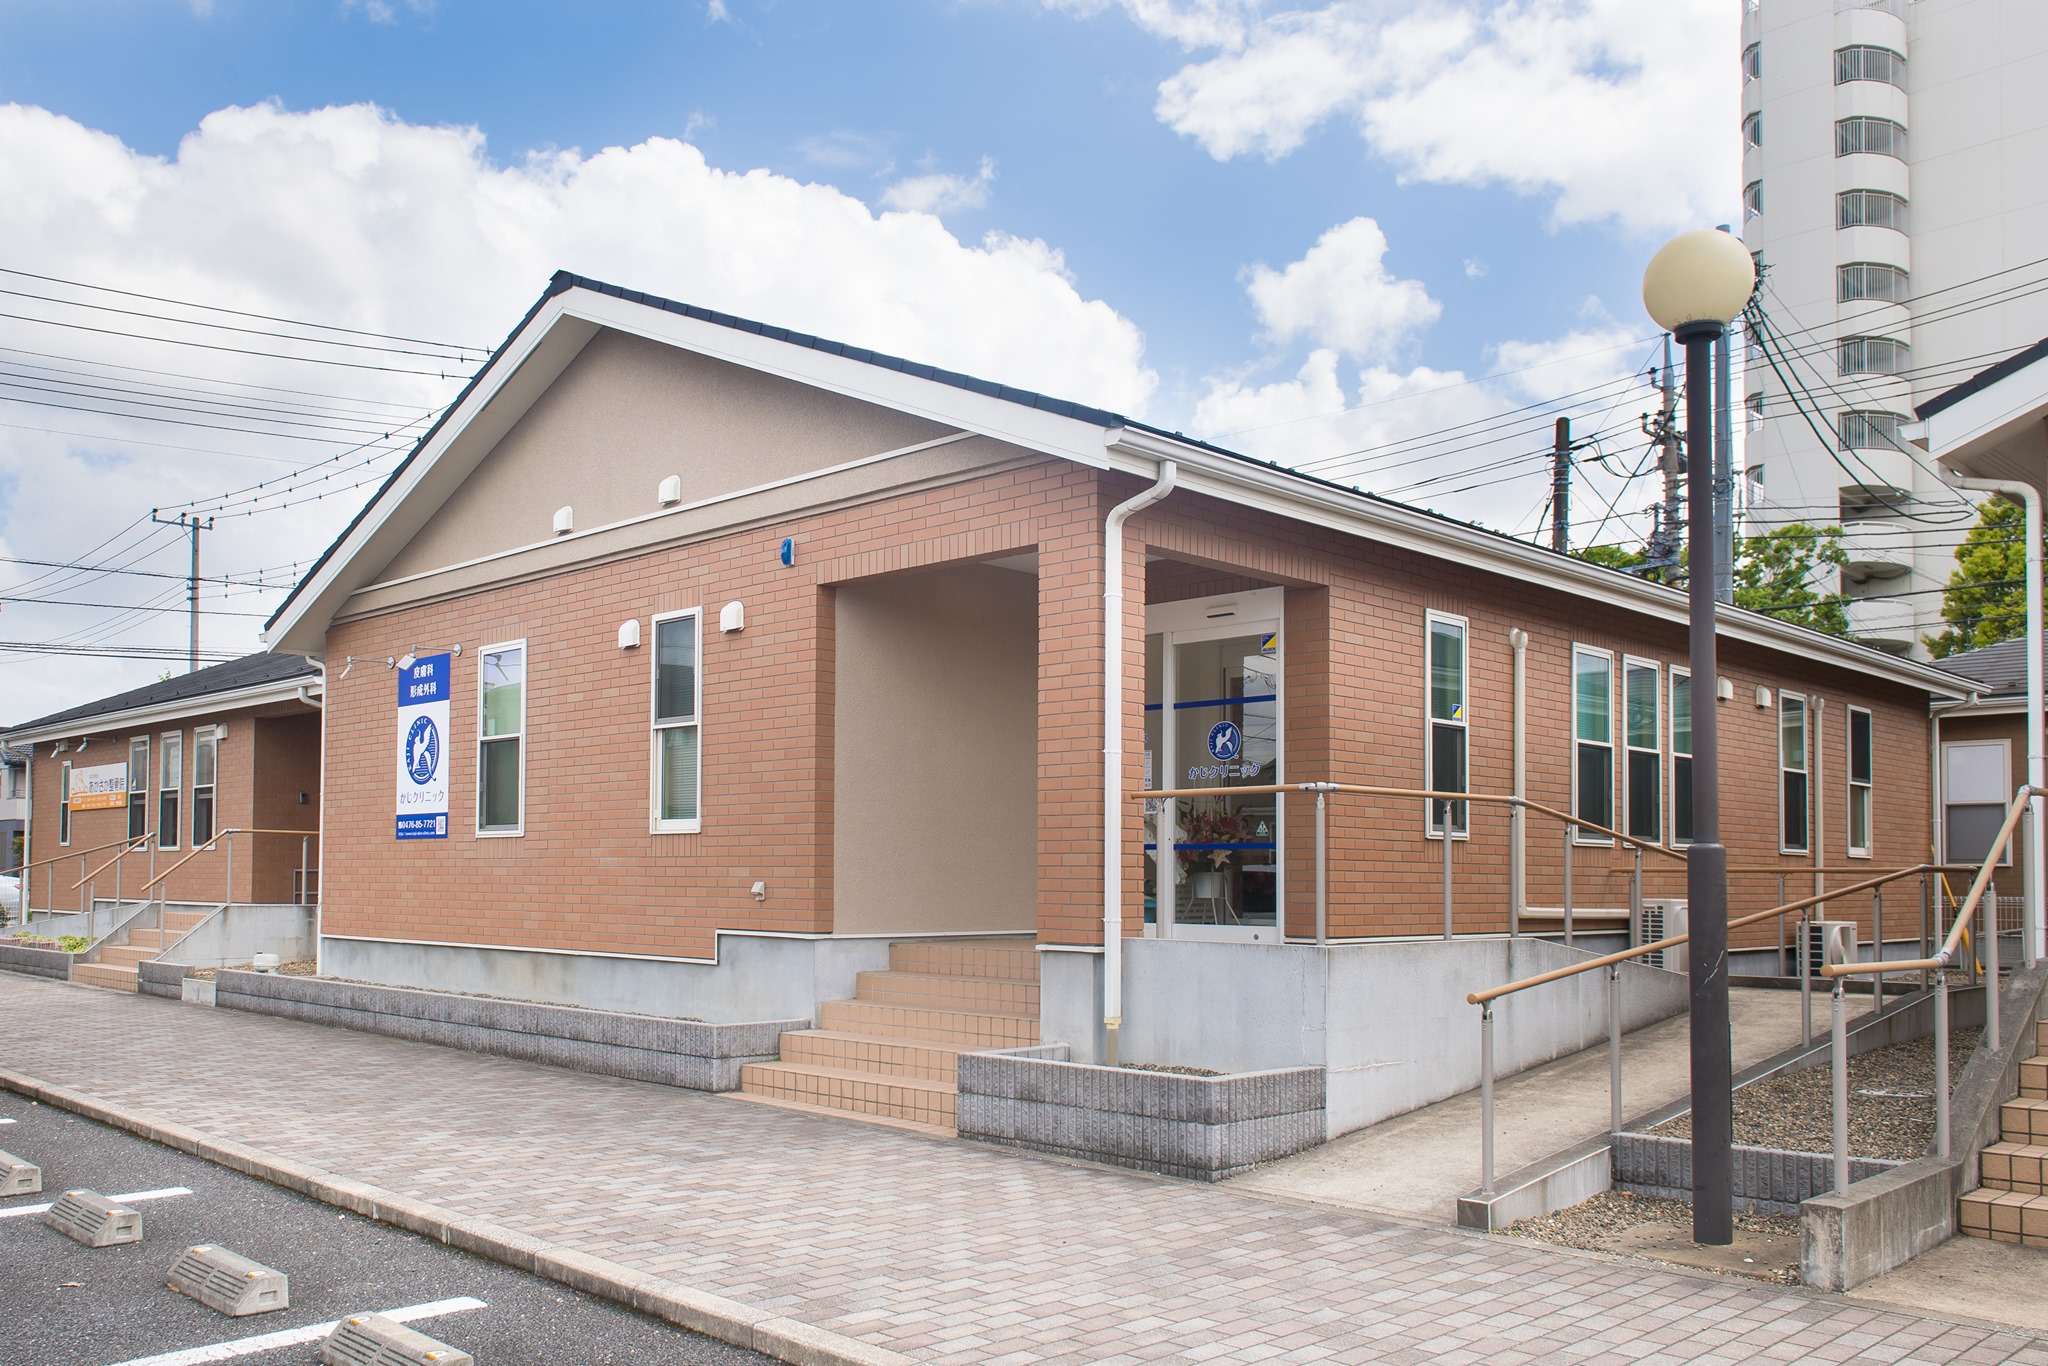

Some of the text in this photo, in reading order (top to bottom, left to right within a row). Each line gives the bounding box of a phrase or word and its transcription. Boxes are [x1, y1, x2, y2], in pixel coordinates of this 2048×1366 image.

[413, 663, 433, 679] 皮膚科
[410, 681, 437, 698] 形成外科
[1189, 763, 1260, 779] かじクリニック
[400, 789, 445, 804] かじクリニック
[402, 819, 436, 829] 0476-85-7721
